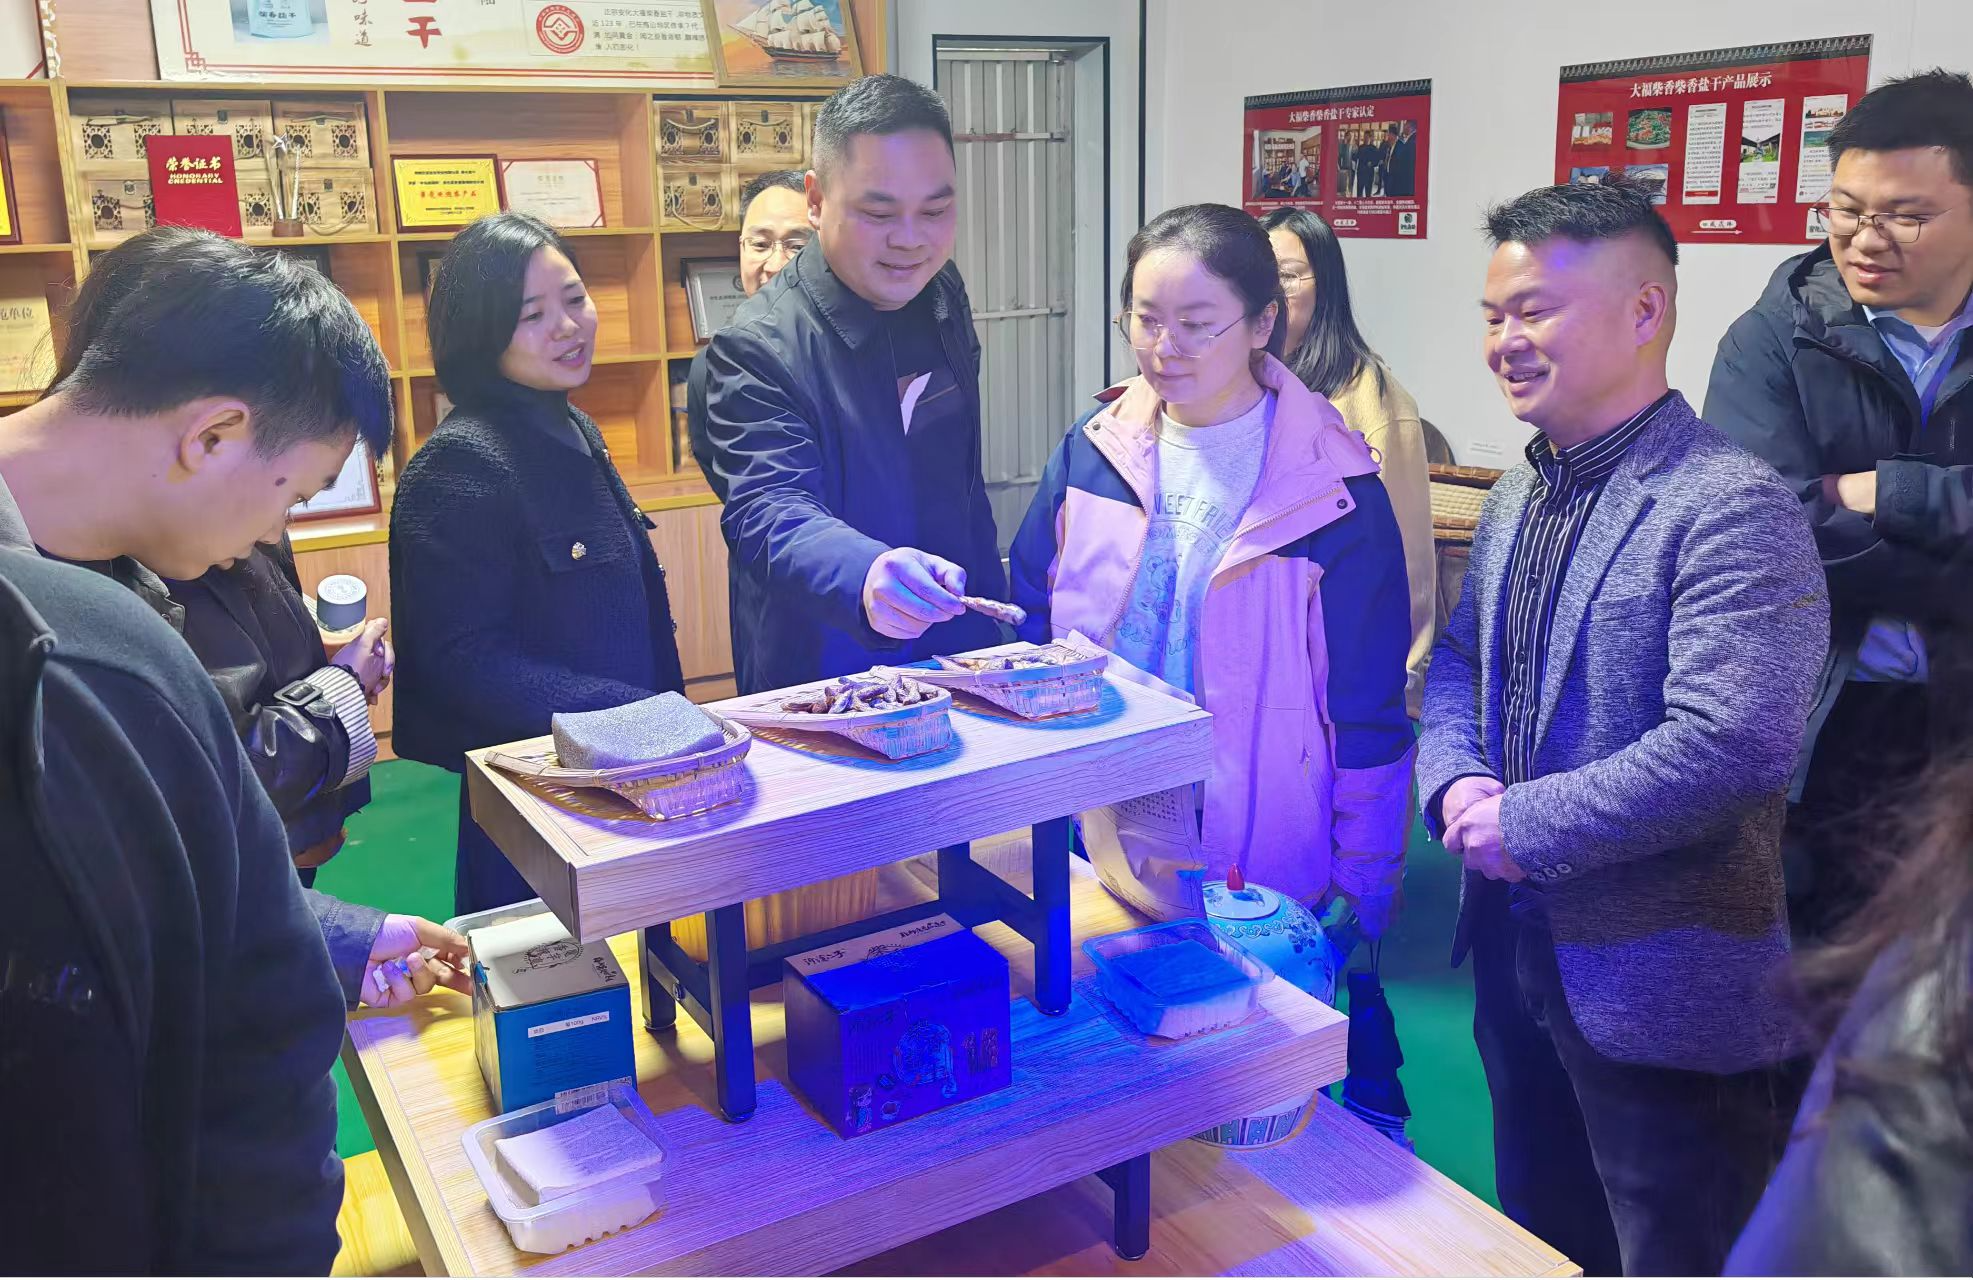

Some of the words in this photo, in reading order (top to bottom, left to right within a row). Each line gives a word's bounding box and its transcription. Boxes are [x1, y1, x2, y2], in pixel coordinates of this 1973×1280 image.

[353, 0, 374, 47] 味道
[1629, 71, 1773, 99] 大福柴香柴香盐干产品展示
[166, 156, 221, 171] 荣誉证书
